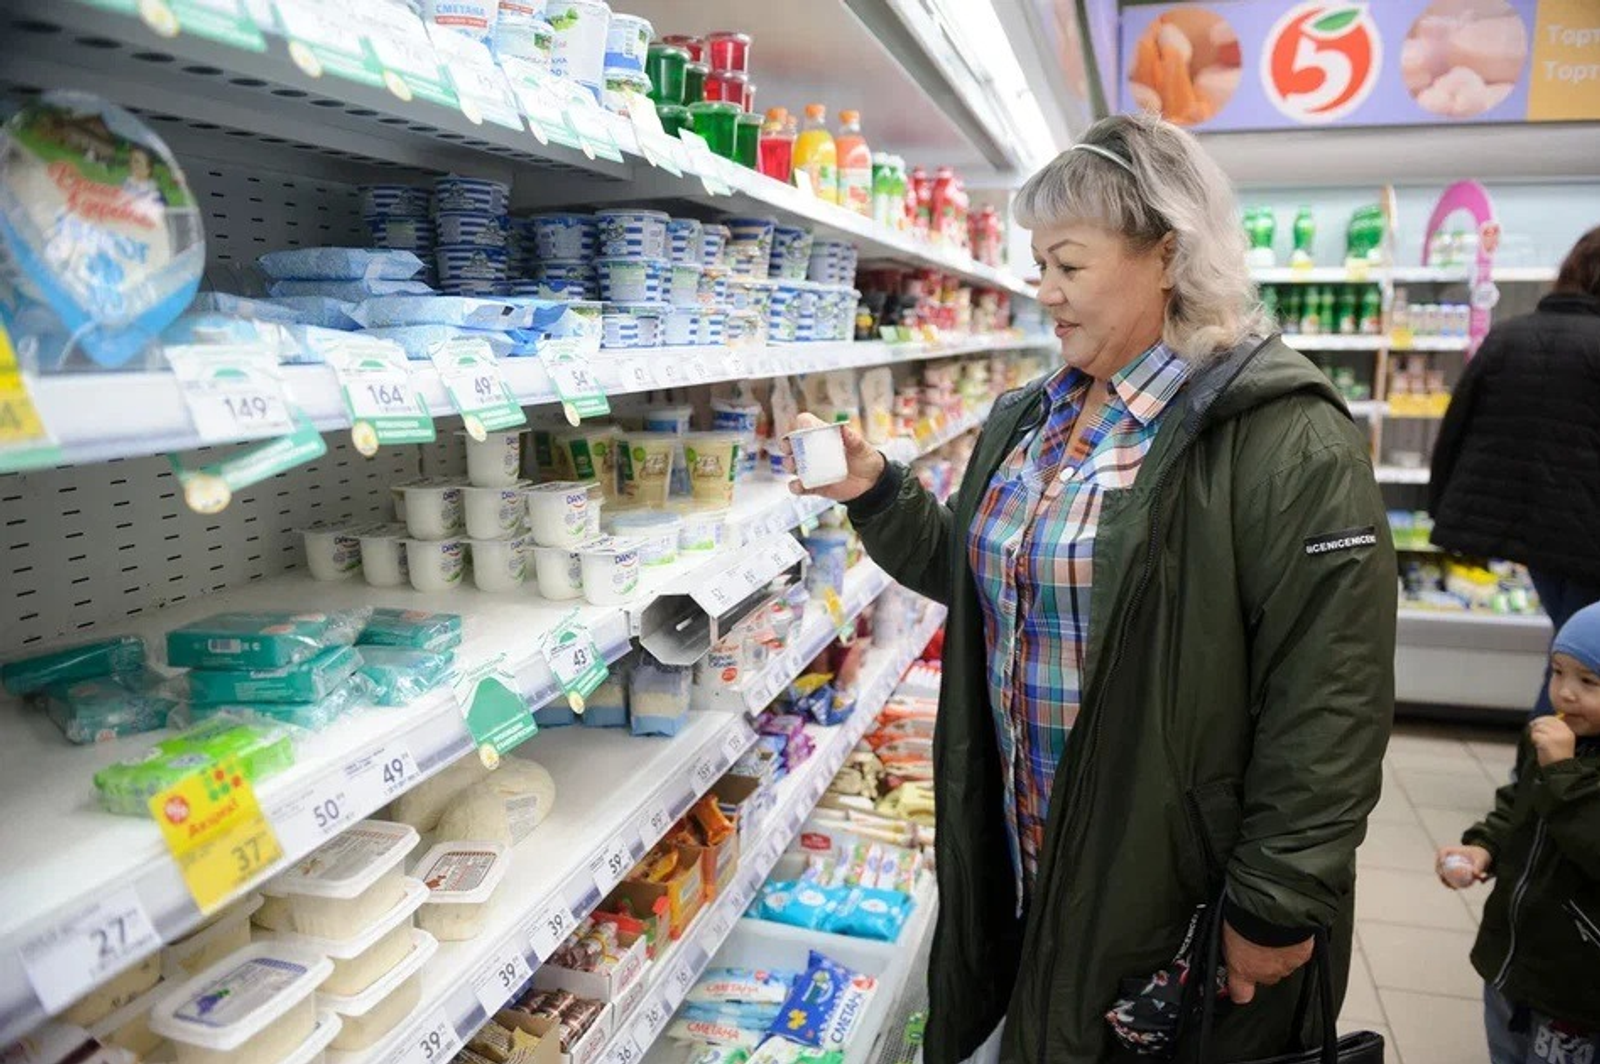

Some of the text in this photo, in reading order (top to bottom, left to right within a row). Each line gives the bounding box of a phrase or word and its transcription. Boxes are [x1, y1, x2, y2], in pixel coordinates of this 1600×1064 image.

[367, 384, 404, 405] 164
[474, 376, 491, 395] 49
[224, 396, 267, 420] 149
[572, 648, 588, 667] 43
[383, 757, 404, 784] 49
[313, 798, 340, 828] 50
[230, 835, 260, 872] 37
[607, 852, 623, 875] 59
[89, 916, 125, 957] 27
[547, 913, 564, 937] 39
[498, 961, 516, 988] 39
[686, 1021, 741, 1042] СМЕТАНА
[420, 1030, 441, 1060] 39
